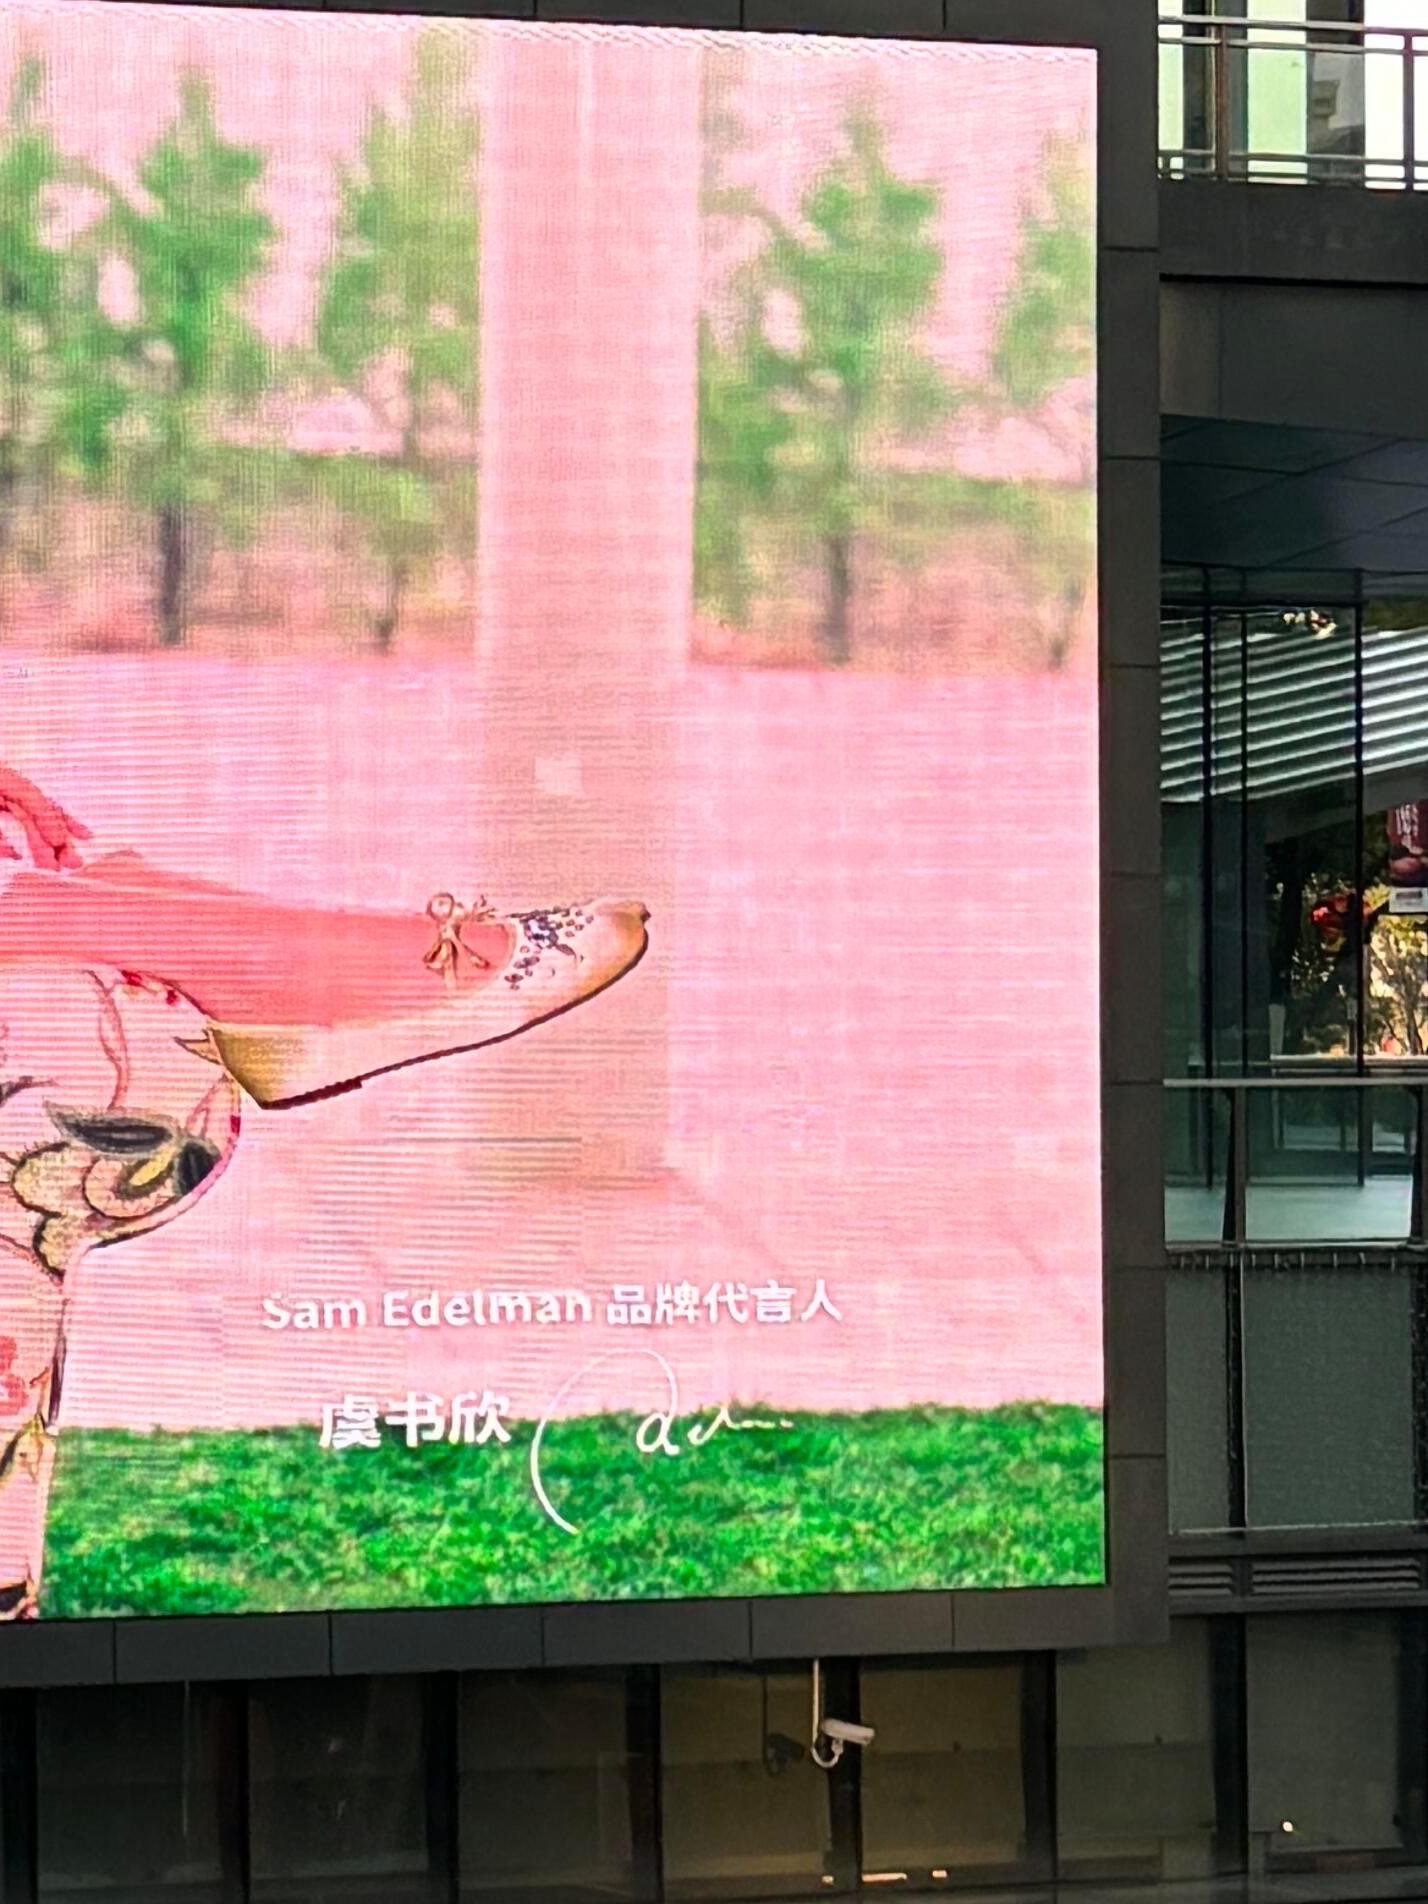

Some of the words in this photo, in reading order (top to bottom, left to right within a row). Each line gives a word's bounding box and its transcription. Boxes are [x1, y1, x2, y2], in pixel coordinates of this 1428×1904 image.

[262, 1290, 367, 1331] Sam
[383, 1286, 593, 1327] Edelman
[606, 1279, 843, 1326] 品牌代言人
[318, 1390, 512, 1451] 虞书欣
